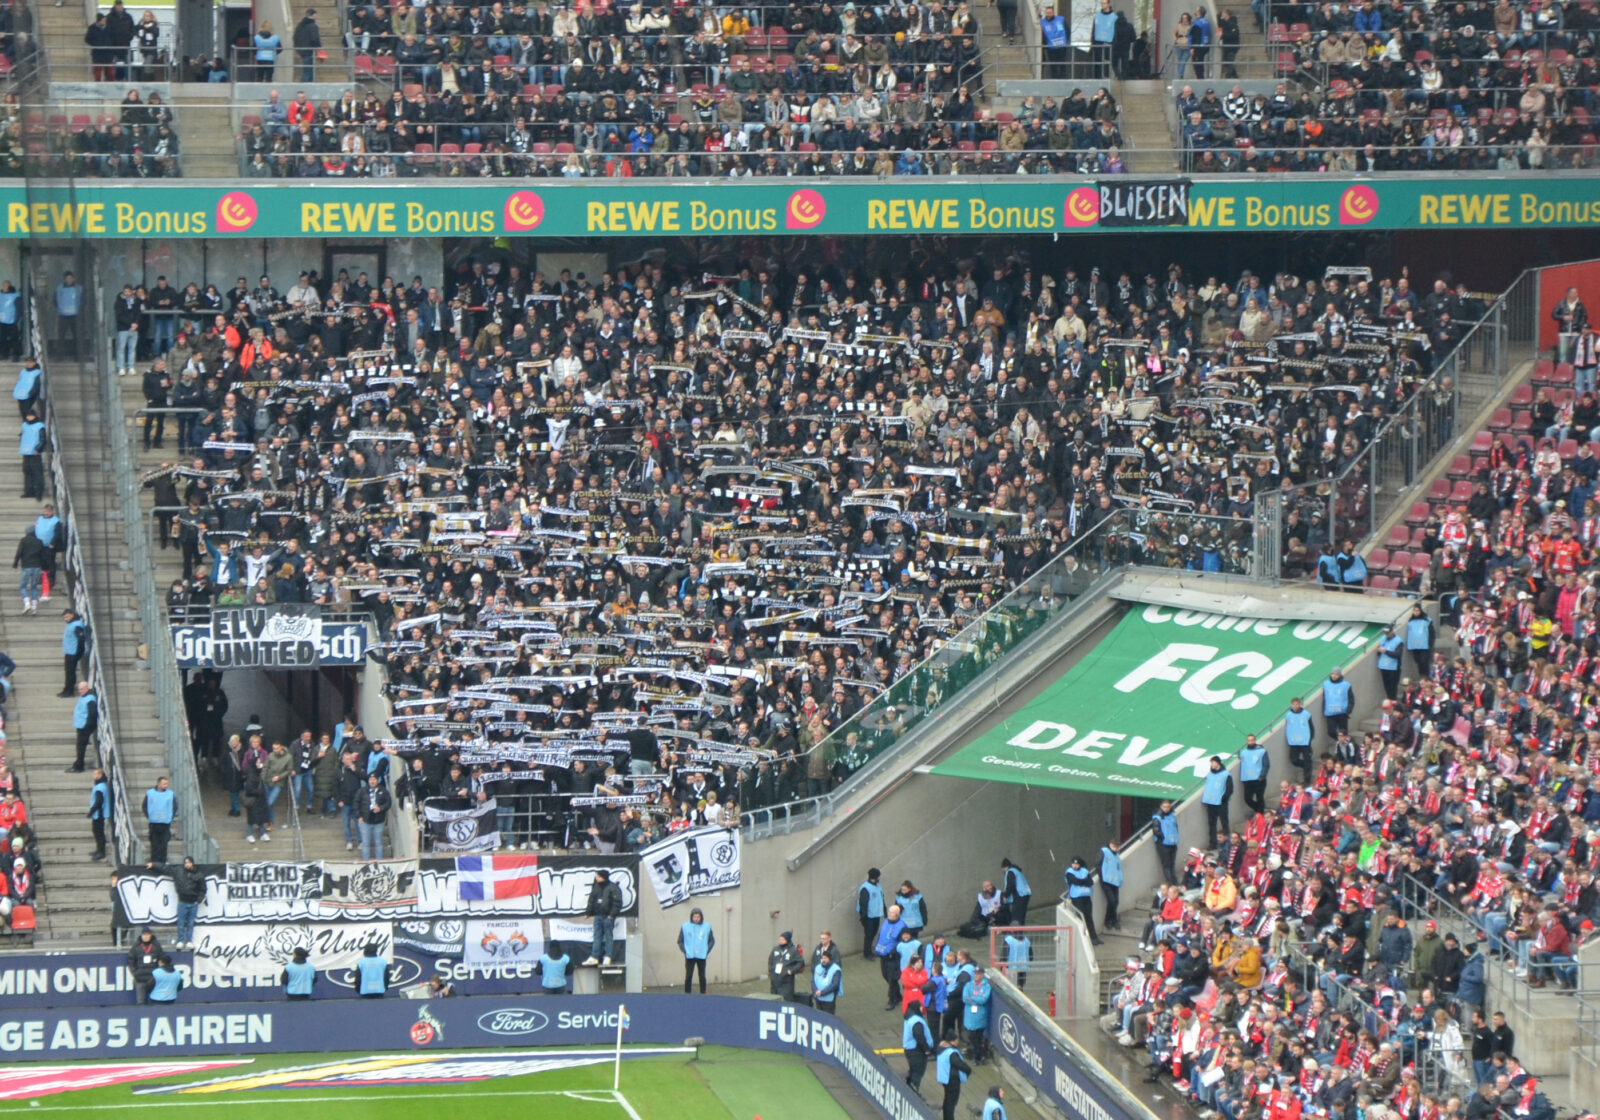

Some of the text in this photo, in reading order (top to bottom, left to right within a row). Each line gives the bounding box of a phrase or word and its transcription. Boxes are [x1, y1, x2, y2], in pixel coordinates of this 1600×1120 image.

[7, 202, 207, 234] REWE Bonus
[301, 202, 495, 233] REWE Bonus
[586, 201, 777, 231] REWE Bonus
[867, 199, 1055, 229] REWE Bonus
[1187, 197, 1331, 227] WE Bonus
[1419, 193, 1600, 224] REWE Bonus
[212, 608, 267, 642] ELV
[211, 640, 316, 668] UNITED
[1113, 642, 1312, 710] FC!
[1006, 720, 1234, 780] DEVK
[980, 755, 1041, 771] Gesagt.
[1047, 763, 1101, 780] Getan.
[228, 883, 300, 900] KOLLEKTIV
[323, 869, 417, 895] H F
[194, 934, 262, 968] Loyal
[0, 1013, 272, 1052] GE AB 5 JAHREN
[491, 1011, 536, 1031] Ford
[759, 1006, 808, 1048] FÜR
[1020, 1035, 1043, 1076] Service
